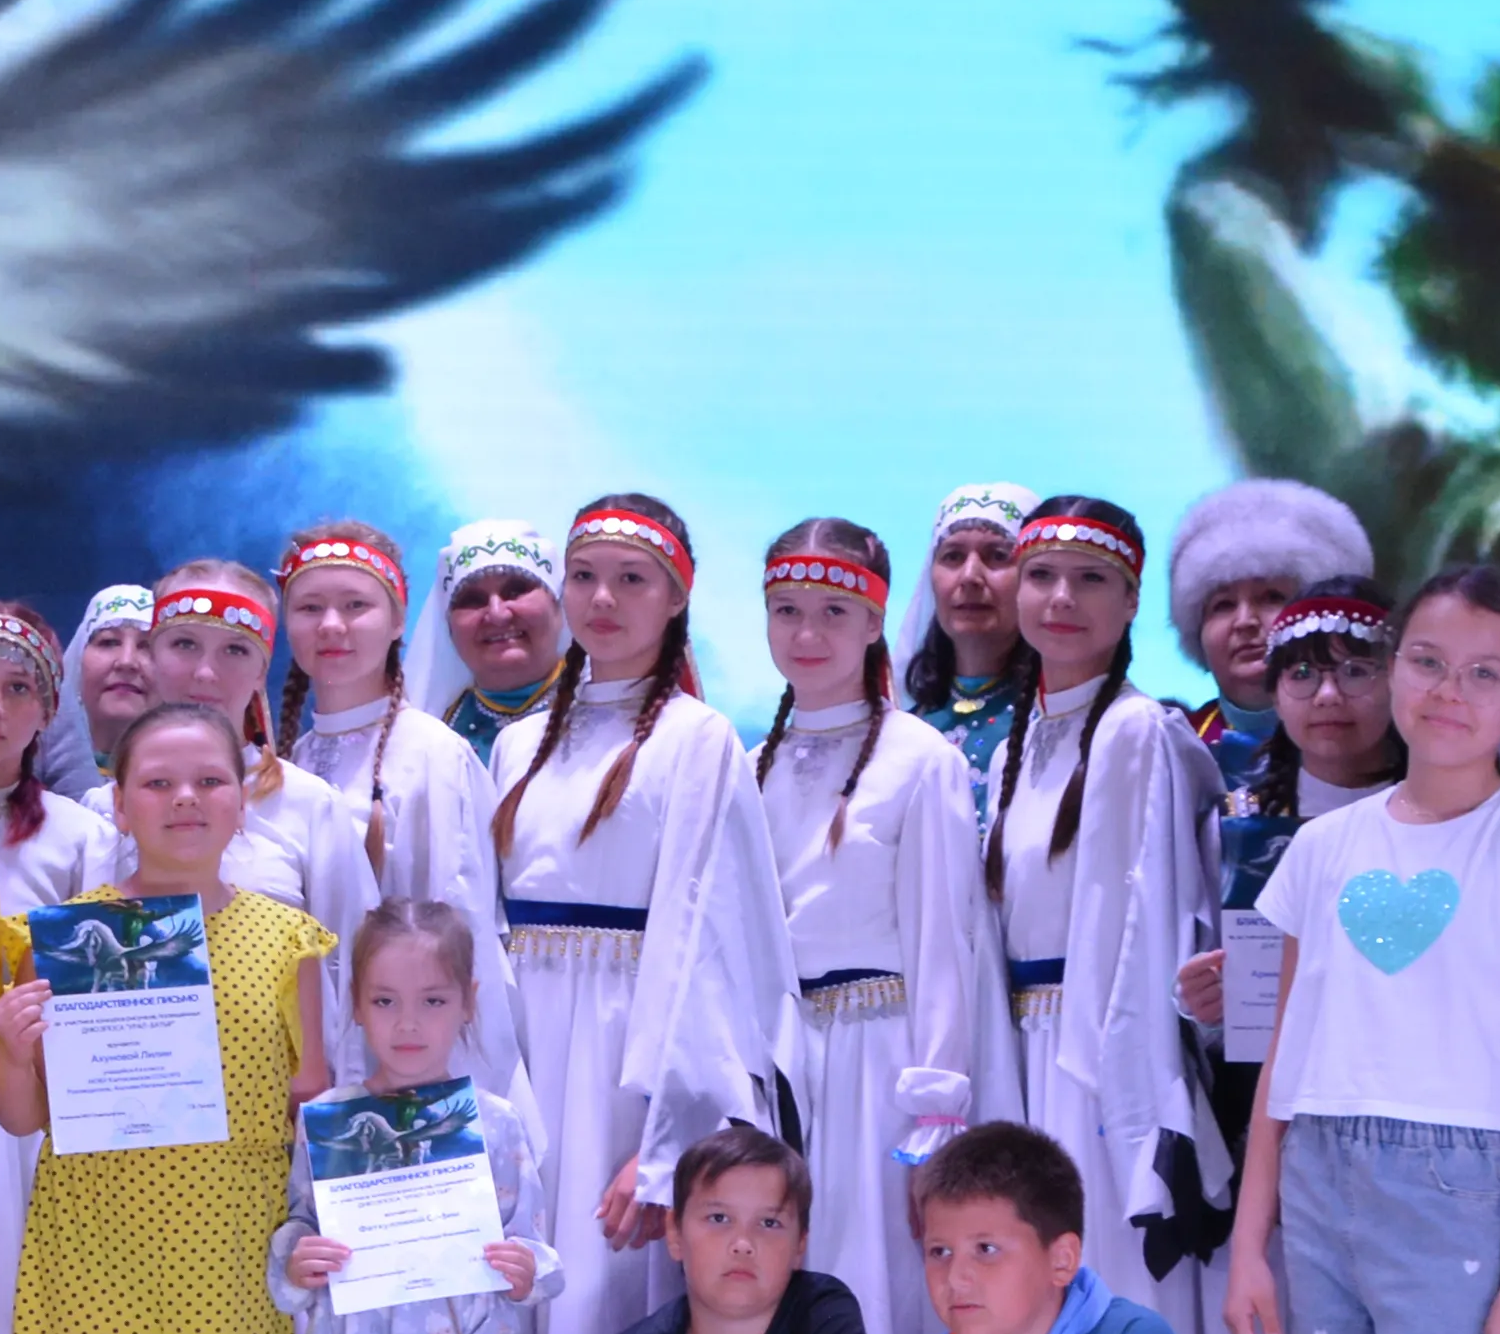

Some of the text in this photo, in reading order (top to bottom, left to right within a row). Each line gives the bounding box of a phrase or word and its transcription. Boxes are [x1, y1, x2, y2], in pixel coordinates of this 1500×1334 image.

[54, 992, 199, 1013] БЛАГОДАРСТВЕННОЕ ПИСЬМО
[329, 1170, 430, 1193] БЛАГОДАРСТВЕННОЕ
[432, 1162, 475, 1176] ПИСЬМО
